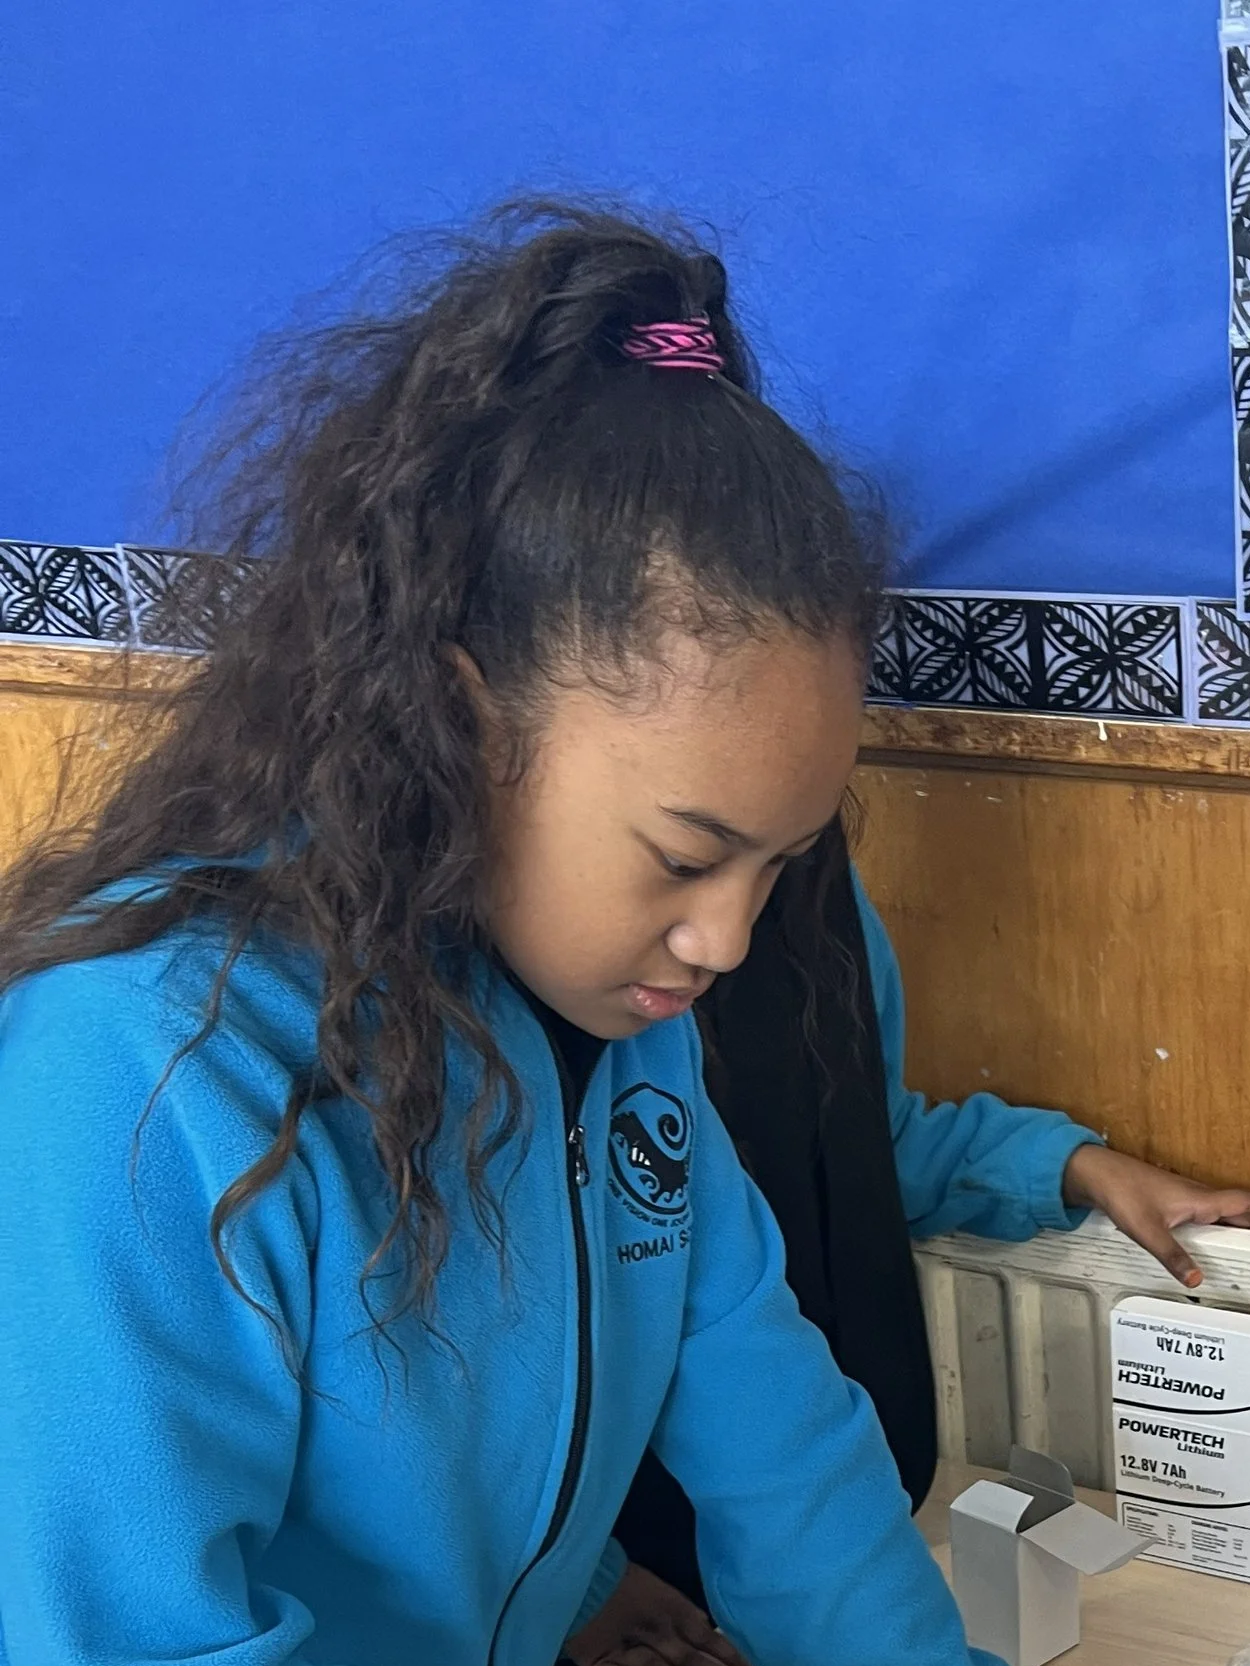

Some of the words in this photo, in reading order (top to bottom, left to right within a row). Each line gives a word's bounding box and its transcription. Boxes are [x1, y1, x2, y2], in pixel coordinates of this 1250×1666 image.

[616, 1233, 674, 1265] HOMAI
[1117, 1317, 1148, 1331] Battery
[1148, 1323, 1192, 1339] Deep-Cycle
[1156, 1337, 1183, 1354] 7Ah
[1194, 1331, 1225, 1345] Lithium
[1185, 1342, 1225, 1362] 12.8V
[1117, 1359, 1166, 1375] Lithium
[1118, 1369, 1225, 1400] POWERTECH
[1119, 1417, 1225, 1449] POWERTECH
[1177, 1442, 1225, 1459] Lithium
[1120, 1454, 1157, 1473] 12.8V
[1162, 1461, 1186, 1479] 7Ah
[1120, 1469, 1150, 1483] Lithium
[1152, 1474, 1194, 1491] Deep-Cycle
[1196, 1483, 1225, 1498] Battery
